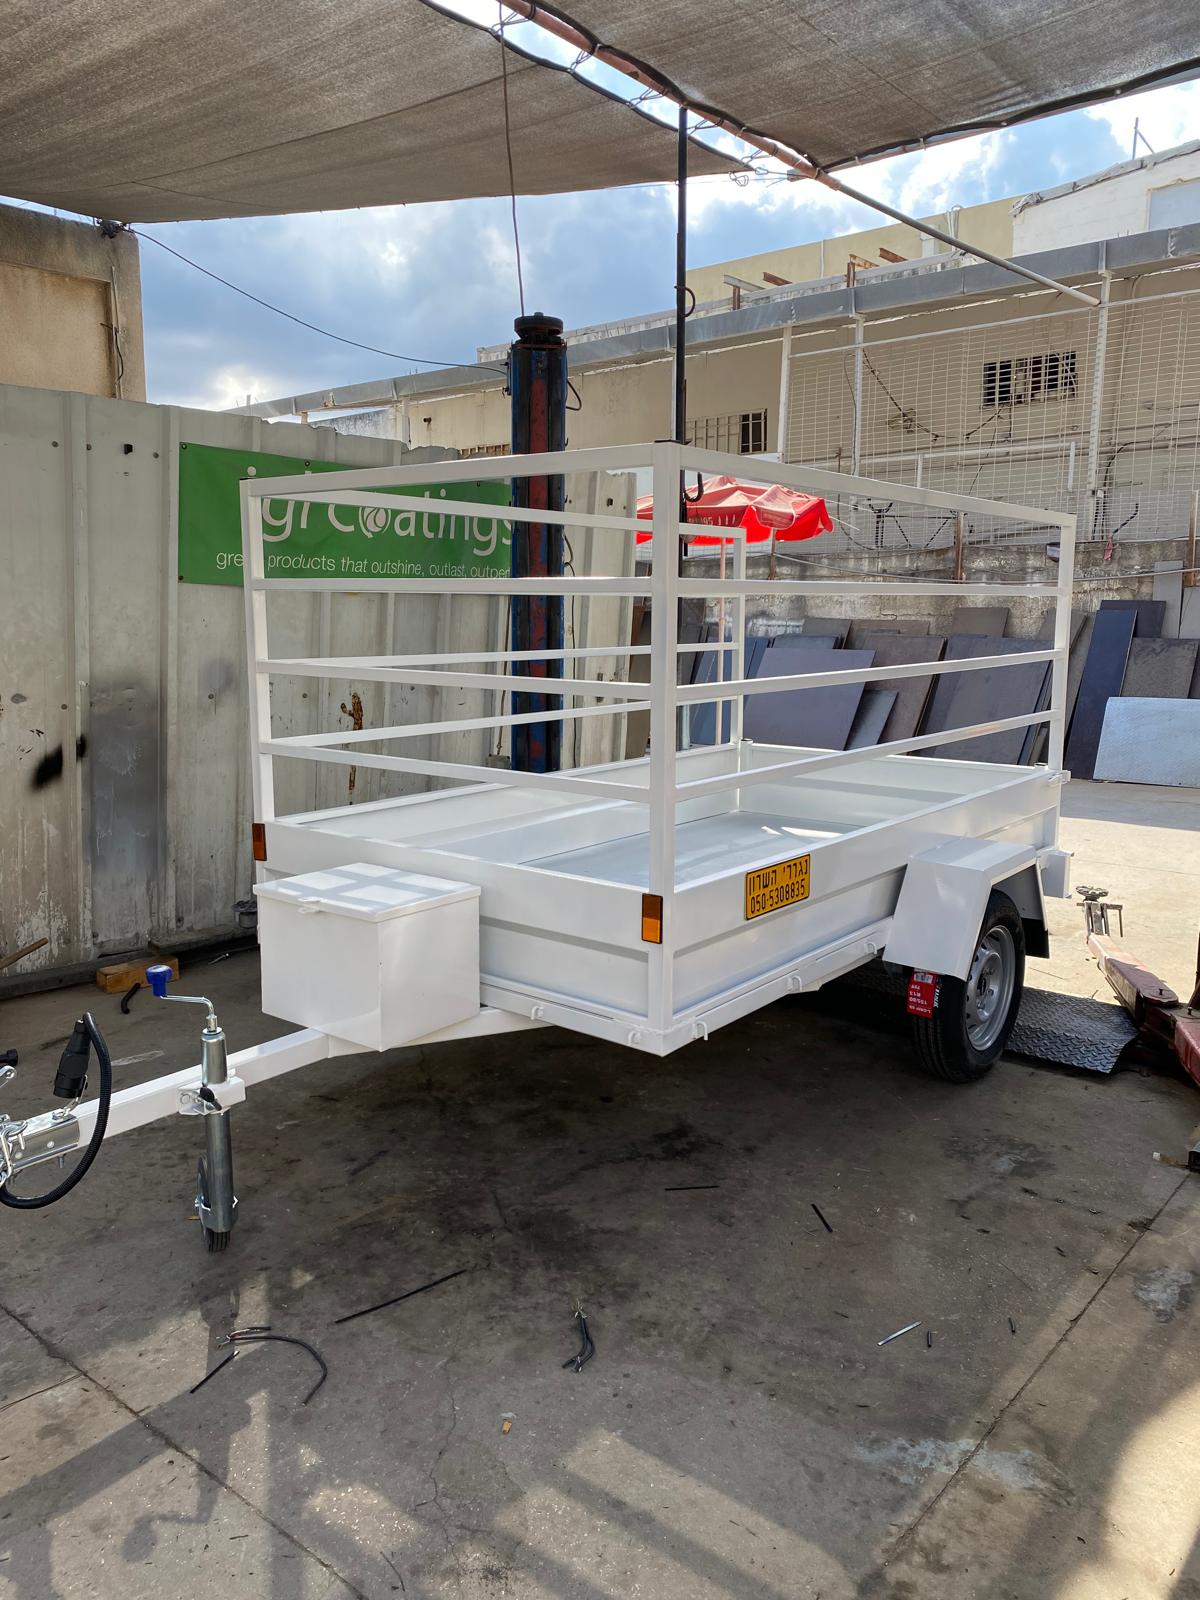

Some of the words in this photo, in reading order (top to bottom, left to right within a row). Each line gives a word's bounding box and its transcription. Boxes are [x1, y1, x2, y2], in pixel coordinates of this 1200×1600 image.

[216, 551, 245, 570] gre
[267, 553, 336, 571] products
[341, 555, 368, 573] that
[371, 559, 425, 577] outshine,
[749, 869, 777, 896] השרון
[750, 878, 806, 914] 050-5308835
